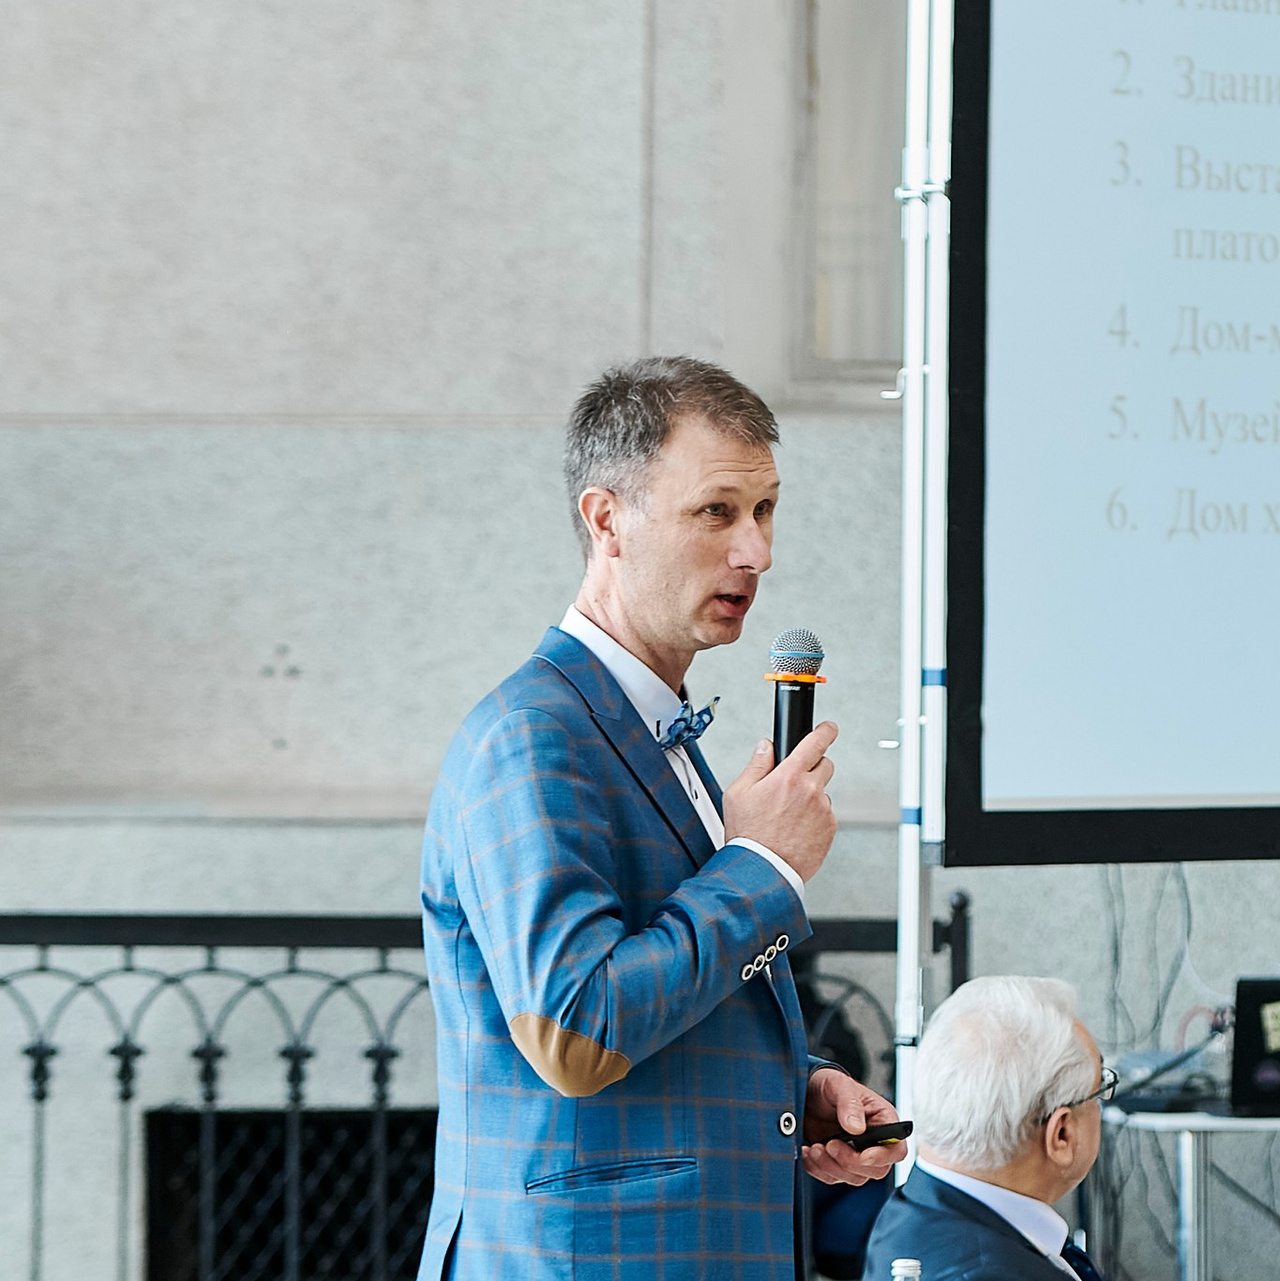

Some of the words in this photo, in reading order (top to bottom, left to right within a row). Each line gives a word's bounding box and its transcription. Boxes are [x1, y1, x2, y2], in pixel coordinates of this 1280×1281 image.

[1110, 48, 1145, 98] 2.
[1109, 139, 1144, 188] 3.
[1107, 303, 1141, 350] 4.
[1107, 395, 1141, 441] 5.
[1105, 486, 1140, 533] 6.
[1167, 486, 1250, 544] Дом
